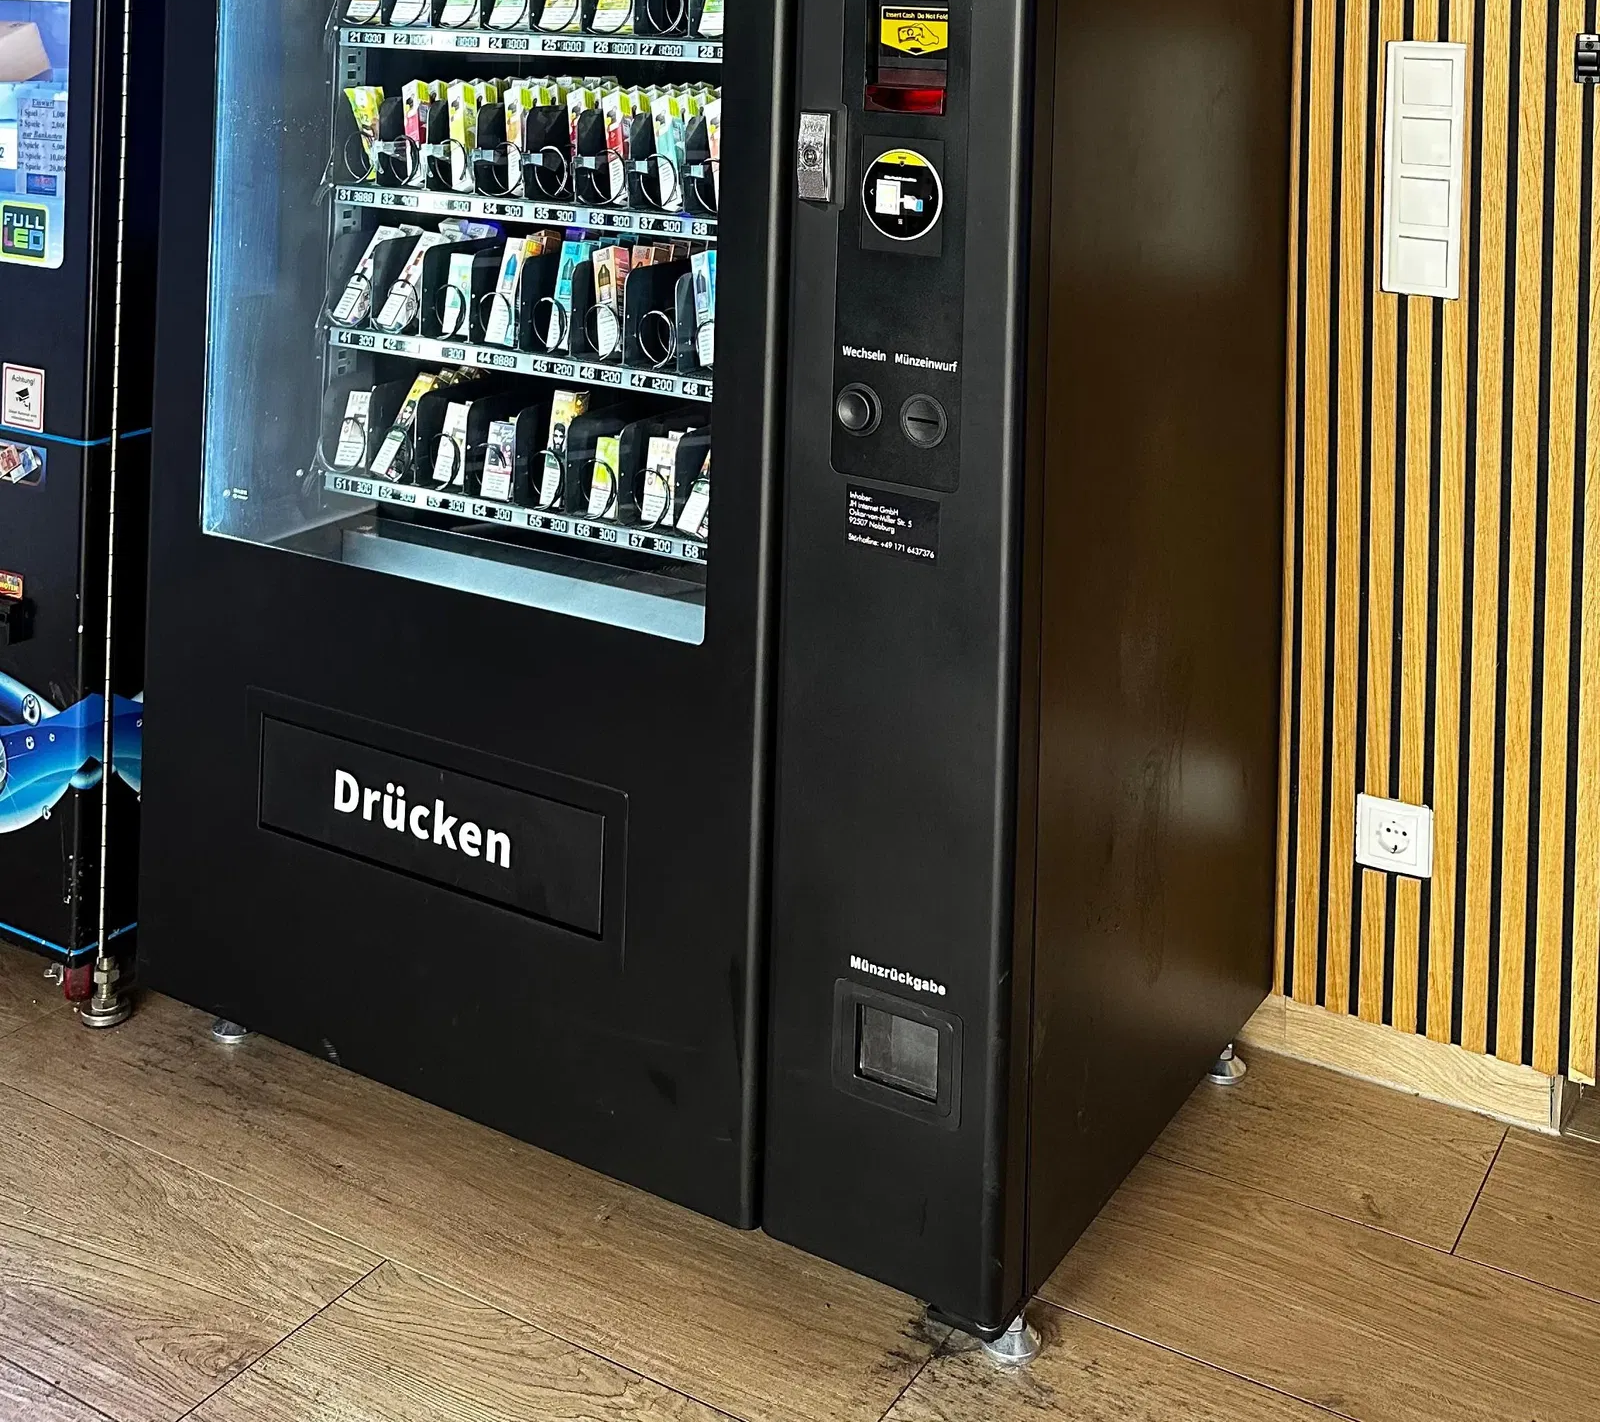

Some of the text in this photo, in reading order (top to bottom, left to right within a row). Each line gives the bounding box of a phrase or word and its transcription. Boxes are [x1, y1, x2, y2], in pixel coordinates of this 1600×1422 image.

[350, 32, 361, 43] 21
[395, 34, 407, 44] 22
[490, 37, 502, 48] 24
[544, 39, 556, 50] 25
[595, 41, 608, 52] 26
[642, 43, 655, 54] 27
[700, 46, 714, 58] 28
[32, 99, 55, 107] Einwurf
[24, 109, 38, 118] Spiel
[24, 120, 40, 130] Spiele
[23, 141, 40, 151] Spiele
[25, 152, 41, 162] Spiele
[25, 163, 41, 171] Spiele
[339, 190, 350, 200] 31
[382, 193, 394, 204] 32
[484, 203, 521, 216] 34 900
[536, 207, 573, 221] 35 900
[3, 212, 44, 230] FULL
[591, 212, 630, 227] 36 900
[640, 217, 680, 233] 37 900
[693, 222, 707, 235] 38
[3, 227, 43, 251] LED
[340, 332, 351, 343] 41
[384, 338, 396, 349] 42
[478, 352, 490, 364] 44
[842, 345, 886, 362] Wechseln
[534, 360, 548, 372] 45
[895, 353, 958, 372] Münzeinwurf
[580, 366, 595, 379] 46
[12, 375, 35, 386] Achtung!
[631, 374, 646, 386] 47
[683, 382, 698, 395] 48
[850, 491, 873, 502] Inhaber:
[474, 504, 487, 516] 54
[879, 506, 899, 516] GmbH
[550, 519, 566, 532] 300
[849, 517, 868, 525] 92507
[908, 520, 912, 528] 5
[599, 529, 615, 542] 300
[631, 535, 671, 552] 57 300
[684, 545, 698, 558] 58
[895, 543, 905, 552] 171
[907, 546, 934, 559] 6437376
[333, 769, 512, 868] Drücken
[850, 955, 946, 996] Münzrückgabe
